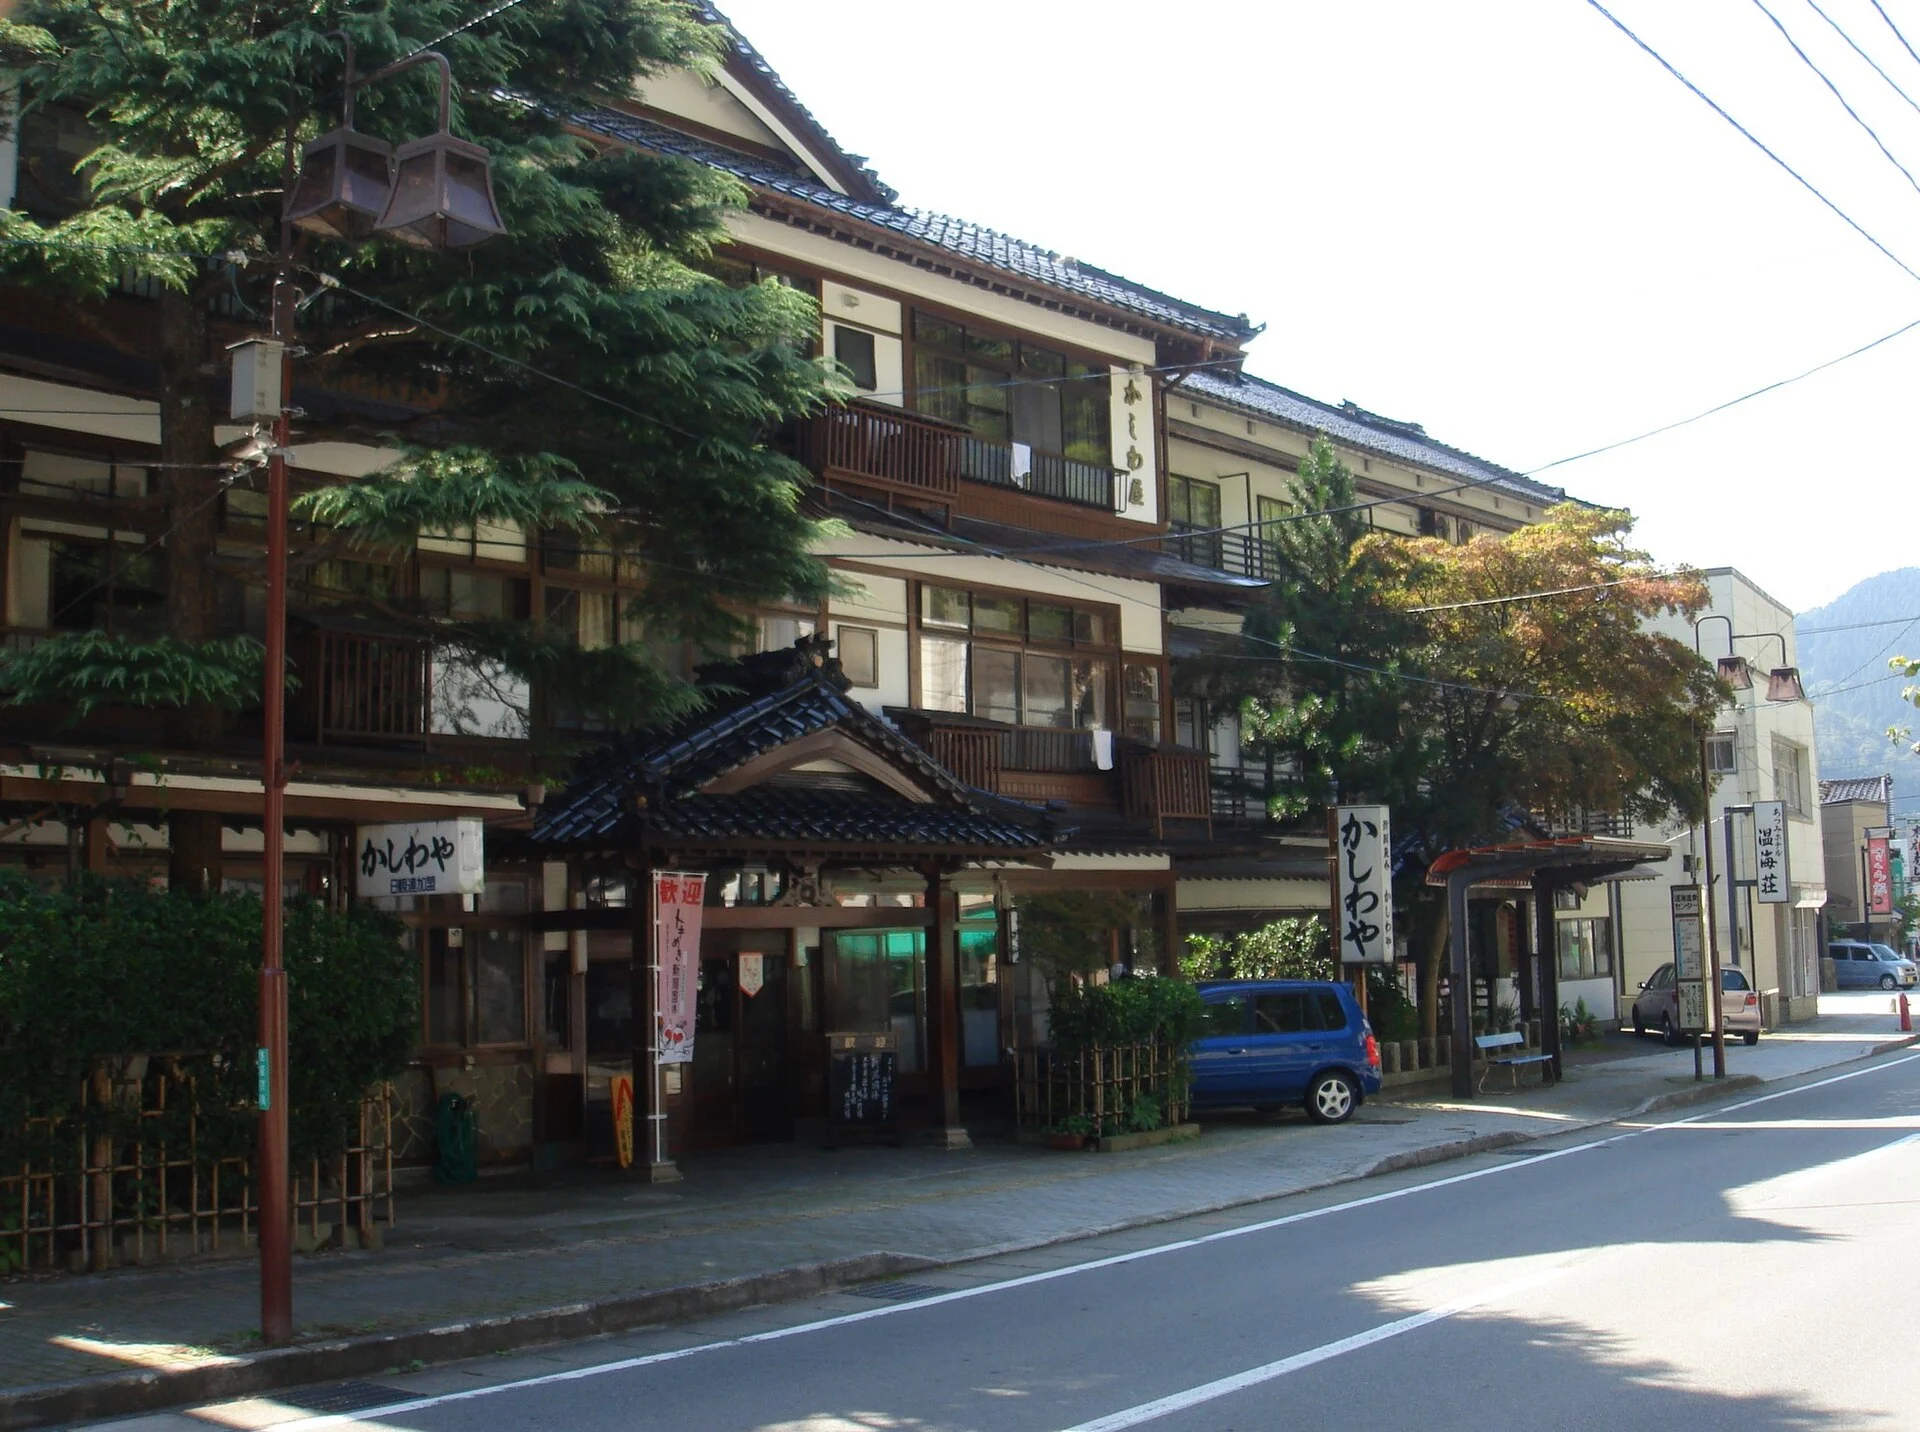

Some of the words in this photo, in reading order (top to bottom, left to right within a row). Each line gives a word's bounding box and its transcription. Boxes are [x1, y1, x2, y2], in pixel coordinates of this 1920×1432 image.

[361, 836, 455, 877] かしわや
[1758, 828, 1778, 894] 温海荘
[660, 879, 704, 905] 歓迎
[1340, 812, 1380, 958] かしわや
